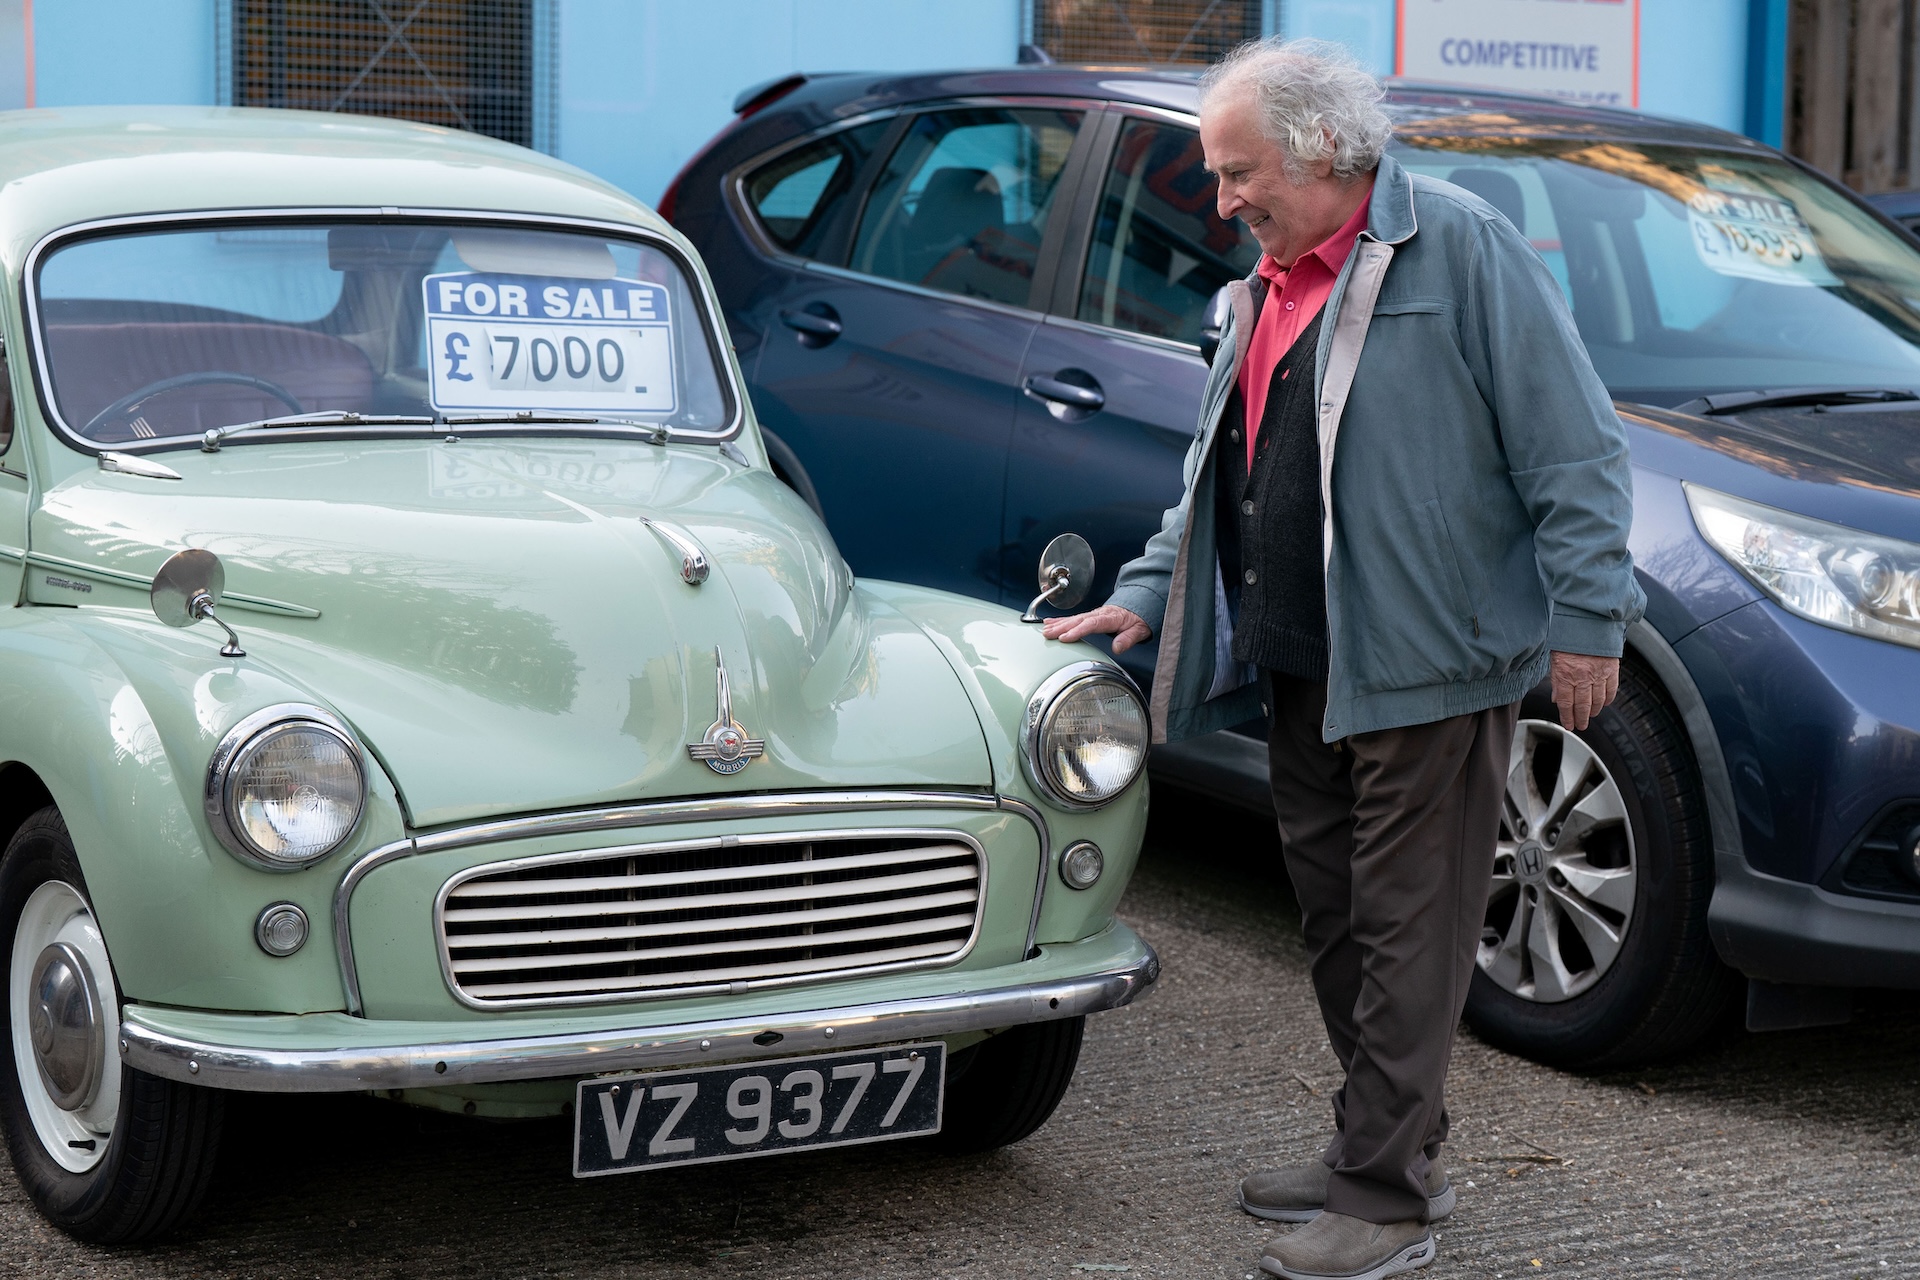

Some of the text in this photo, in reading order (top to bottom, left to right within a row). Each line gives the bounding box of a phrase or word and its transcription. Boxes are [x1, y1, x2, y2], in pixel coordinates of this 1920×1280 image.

[1440, 38, 1600, 72] COMPETITIVE
[1731, 197, 1800, 227] SALE
[438, 281, 657, 320] FOR SALE
[444, 332, 624, 383] £ 7000
[712, 759, 746, 772] MORRIS
[598, 1056, 926, 1160] VZ 9377
